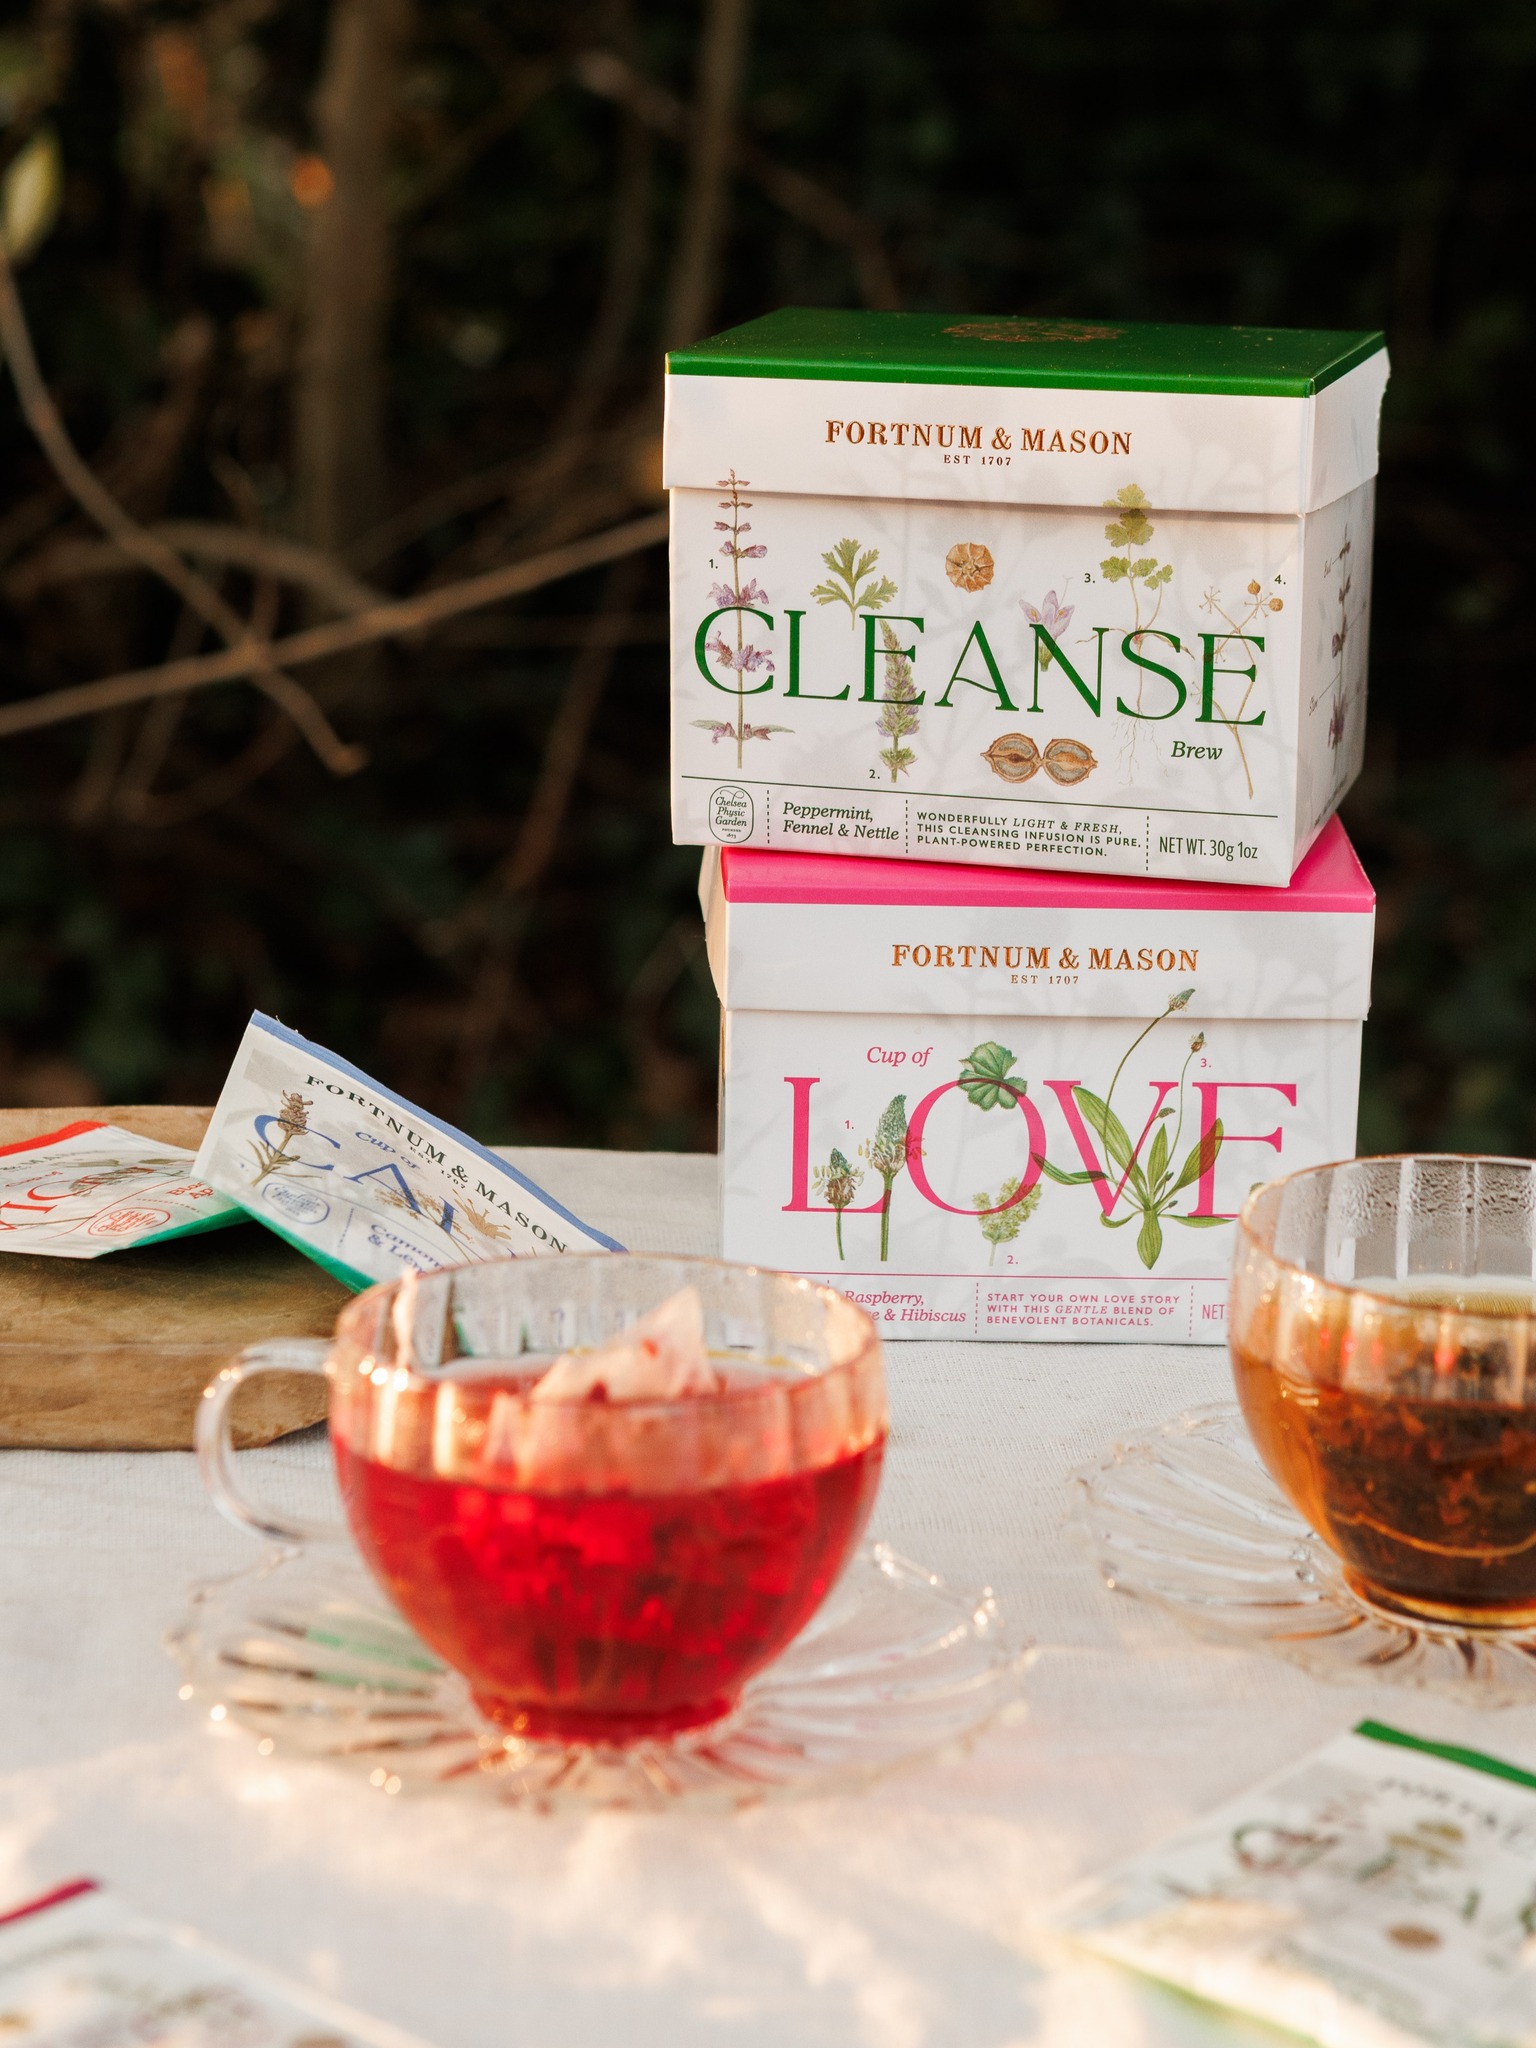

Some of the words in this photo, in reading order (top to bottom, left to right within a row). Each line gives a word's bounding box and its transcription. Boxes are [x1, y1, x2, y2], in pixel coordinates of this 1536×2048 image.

[825, 419, 983, 450] FORTNUM
[991, 427, 1012, 450] &
[1020, 427, 1133, 455] MASON
[943, 454, 971, 465] EST
[981, 456, 1012, 467] 1707
[708, 558, 718, 569] 1.
[1083, 573, 1096, 584] 3.
[1274, 574, 1286, 585] 4.
[694, 606, 1267, 726] CLEANSE
[1171, 740, 1223, 760] Brew
[869, 769, 880, 779] 2.
[715, 791, 747, 807] Chelsea
[717, 806, 745, 817] Physic
[782, 801, 873, 822] Peppermint,
[715, 815, 747, 826] Garden
[917, 811, 1008, 826] WONDERFULLY
[1012, 817, 1055, 829] LIGHT
[1060, 821, 1069, 830] &
[1074, 822, 1123, 835] FRESH,
[782, 820, 833, 836] Fennel
[837, 823, 849, 837] &
[853, 825, 899, 840] Nettle
[917, 823, 944, 833] THIS
[949, 825, 1020, 839] CLEANSING
[1024, 830, 1085, 843] INFUSION
[1090, 835, 1101, 844] IS
[917, 835, 1021, 850] PLANT-POWERED
[1026, 842, 1107, 857] PERFECTION.
[1159, 836, 1183, 853] NET
[1186, 838, 1206, 856] WT.
[1209, 839, 1234, 861] 30g
[1237, 841, 1258, 859] 1oz
[891, 944, 1050, 969] FORTNUM
[1058, 947, 1080, 970] &
[1088, 947, 1199, 972] MASON
[1010, 974, 1038, 984] EST
[1048, 975, 1080, 985] 1707
[866, 1046, 906, 1066] Cup
[911, 1047, 933, 1067] of
[1200, 1058, 1212, 1068] 3.
[844, 1120, 855, 1129] 1.
[355, 1131, 396, 1153] Cup
[400, 1155, 420, 1169] of
[782, 1076, 1297, 1217] LOVE
[304, 1073, 448, 1167] FORTNUM
[451, 1165, 468, 1183] &
[475, 1180, 568, 1253] MASON
[1007, 1255, 1018, 1265] 2.
[844, 1290, 924, 1306] Raspberry,
[987, 1293, 1024, 1302] START
[1030, 1294, 1064, 1302] YOUR
[1069, 1294, 1099, 1303] OWN
[1104, 1295, 1134, 1304] LOVE
[1140, 1295, 1180, 1304] STORY
[884, 1308, 896, 1321] &
[900, 1308, 966, 1322] Hibiscus
[987, 1304, 1019, 1313] WITH
[1023, 1305, 1050, 1314] THIS
[1055, 1305, 1108, 1315] GENTLE
[1113, 1306, 1153, 1315] BLEND
[1158, 1306, 1175, 1316] OF
[1202, 1304, 1225, 1320] NET
[986, 1315, 1067, 1325] BENEVOLENT
[1072, 1316, 1153, 1326] BOTANICALS.
